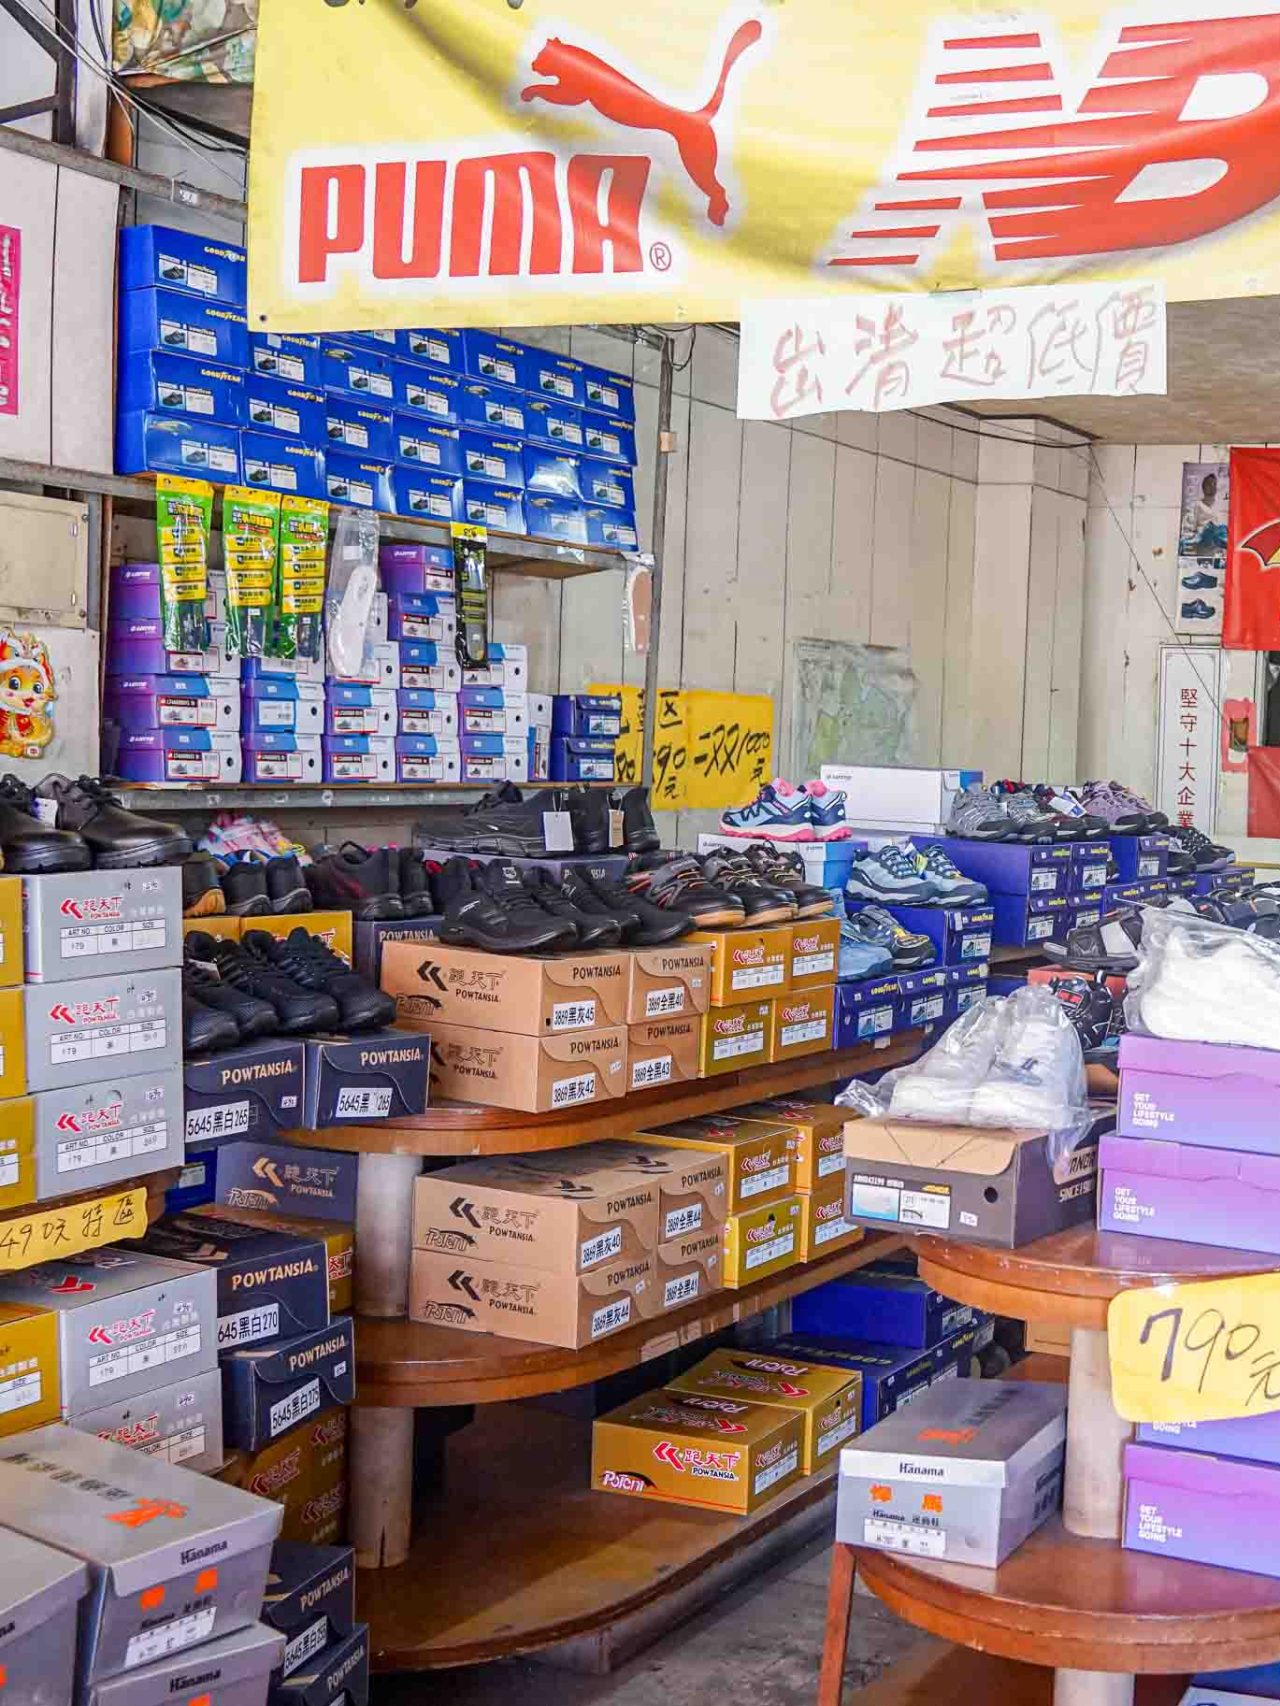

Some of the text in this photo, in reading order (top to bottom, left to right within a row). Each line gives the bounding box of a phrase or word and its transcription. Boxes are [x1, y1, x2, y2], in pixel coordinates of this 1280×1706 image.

[300, 152, 651, 283] PUMA
[573, 964, 621, 980] POWTANSIA
[662, 955, 704, 970] POWTANSIA
[455, 989, 501, 1003] POWTANSIA
[554, 1006, 595, 1026] 3869黑灰45
[647, 1022, 691, 1039] POWTANSIA
[570, 1037, 619, 1054] POWTANSIA
[360, 1048, 420, 1066] POWTANSIA
[221, 1059, 293, 1085] POWTANSIA
[453, 1064, 497, 1079] POWTANSIA
[553, 1078, 595, 1103] 3869黑灰42
[338, 1092, 390, 1113] 5645黑265
[187, 1108, 248, 1136] 5645黑白265
[681, 1167, 722, 1188] POWTANSIA
[607, 1192, 652, 1214] POWTANSIA
[489, 1226, 535, 1242] POWTANSIA
[582, 1234, 621, 1264] 3869黑灰40
[681, 1235, 719, 1257] POWTANSIA
[231, 1259, 314, 1291] POWTANSIA
[607, 1262, 649, 1286] POWTANSIA
[489, 1299, 535, 1315] POWTANSIA
[289, 1334, 346, 1371] POWTANSIA
[684, 1449, 741, 1470] 跑天下
[692, 1467, 735, 1481] POWTANSIA
[300, 1567, 350, 1611] POWTANSIA
